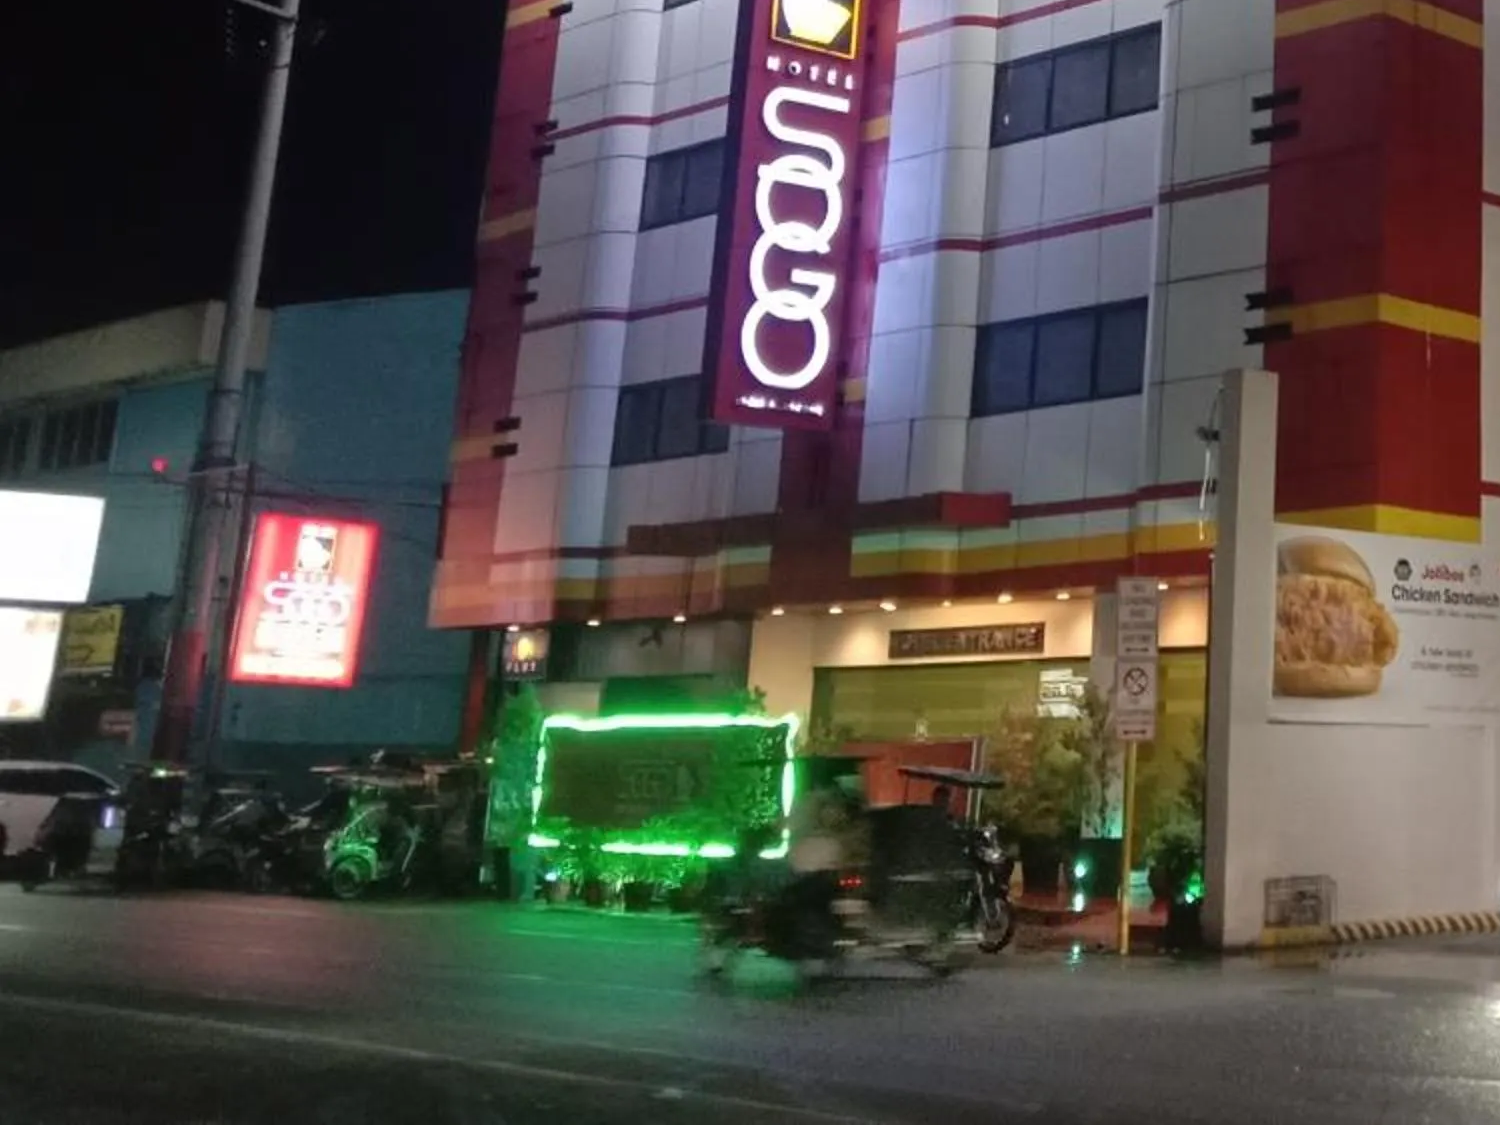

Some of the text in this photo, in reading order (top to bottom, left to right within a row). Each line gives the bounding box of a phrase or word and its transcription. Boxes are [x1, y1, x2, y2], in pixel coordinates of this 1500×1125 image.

[766, 55, 855, 91] HOTEL
[741, 86, 850, 389] SOGO
[1391, 583, 1500, 608] Chicken Sandwich
